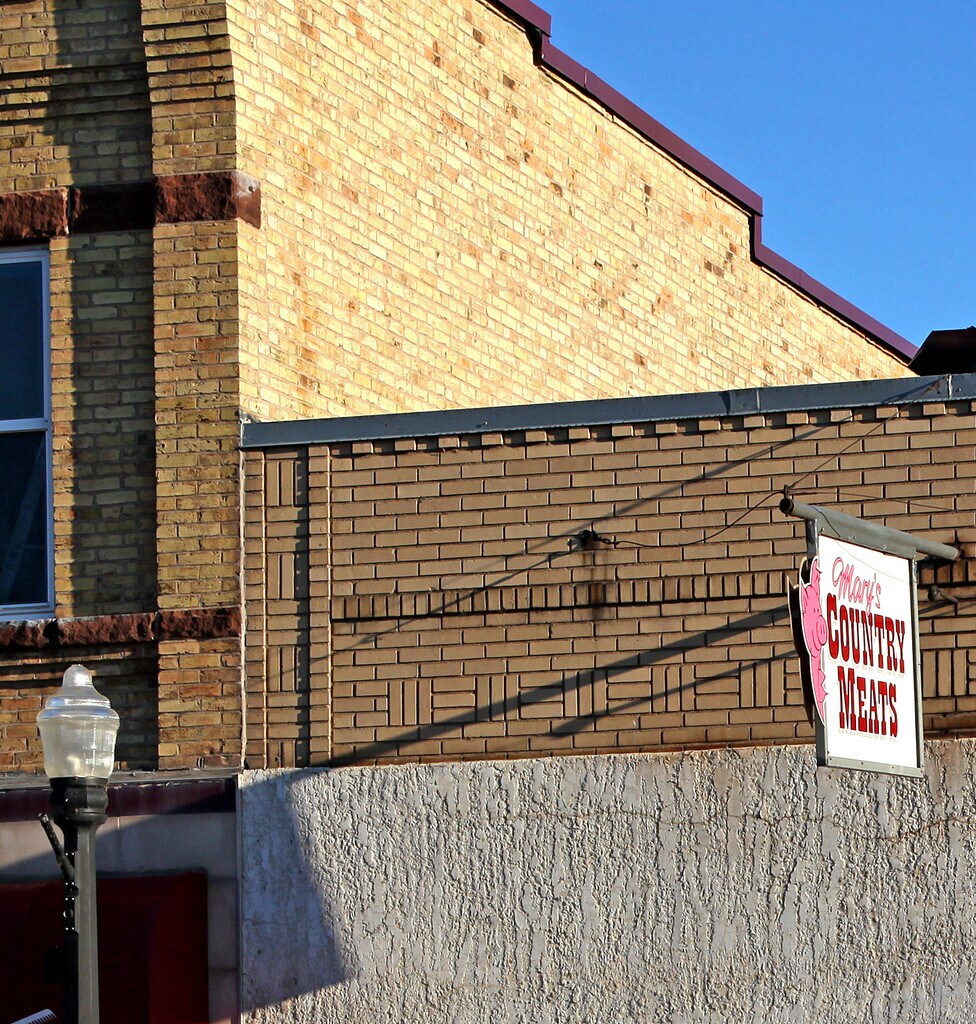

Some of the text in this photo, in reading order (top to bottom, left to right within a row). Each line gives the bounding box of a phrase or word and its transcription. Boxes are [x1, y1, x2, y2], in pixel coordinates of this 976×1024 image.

[832, 556, 882, 615] Mary's
[826, 592, 906, 674] COUNTRY
[837, 665, 899, 739] MEATS
